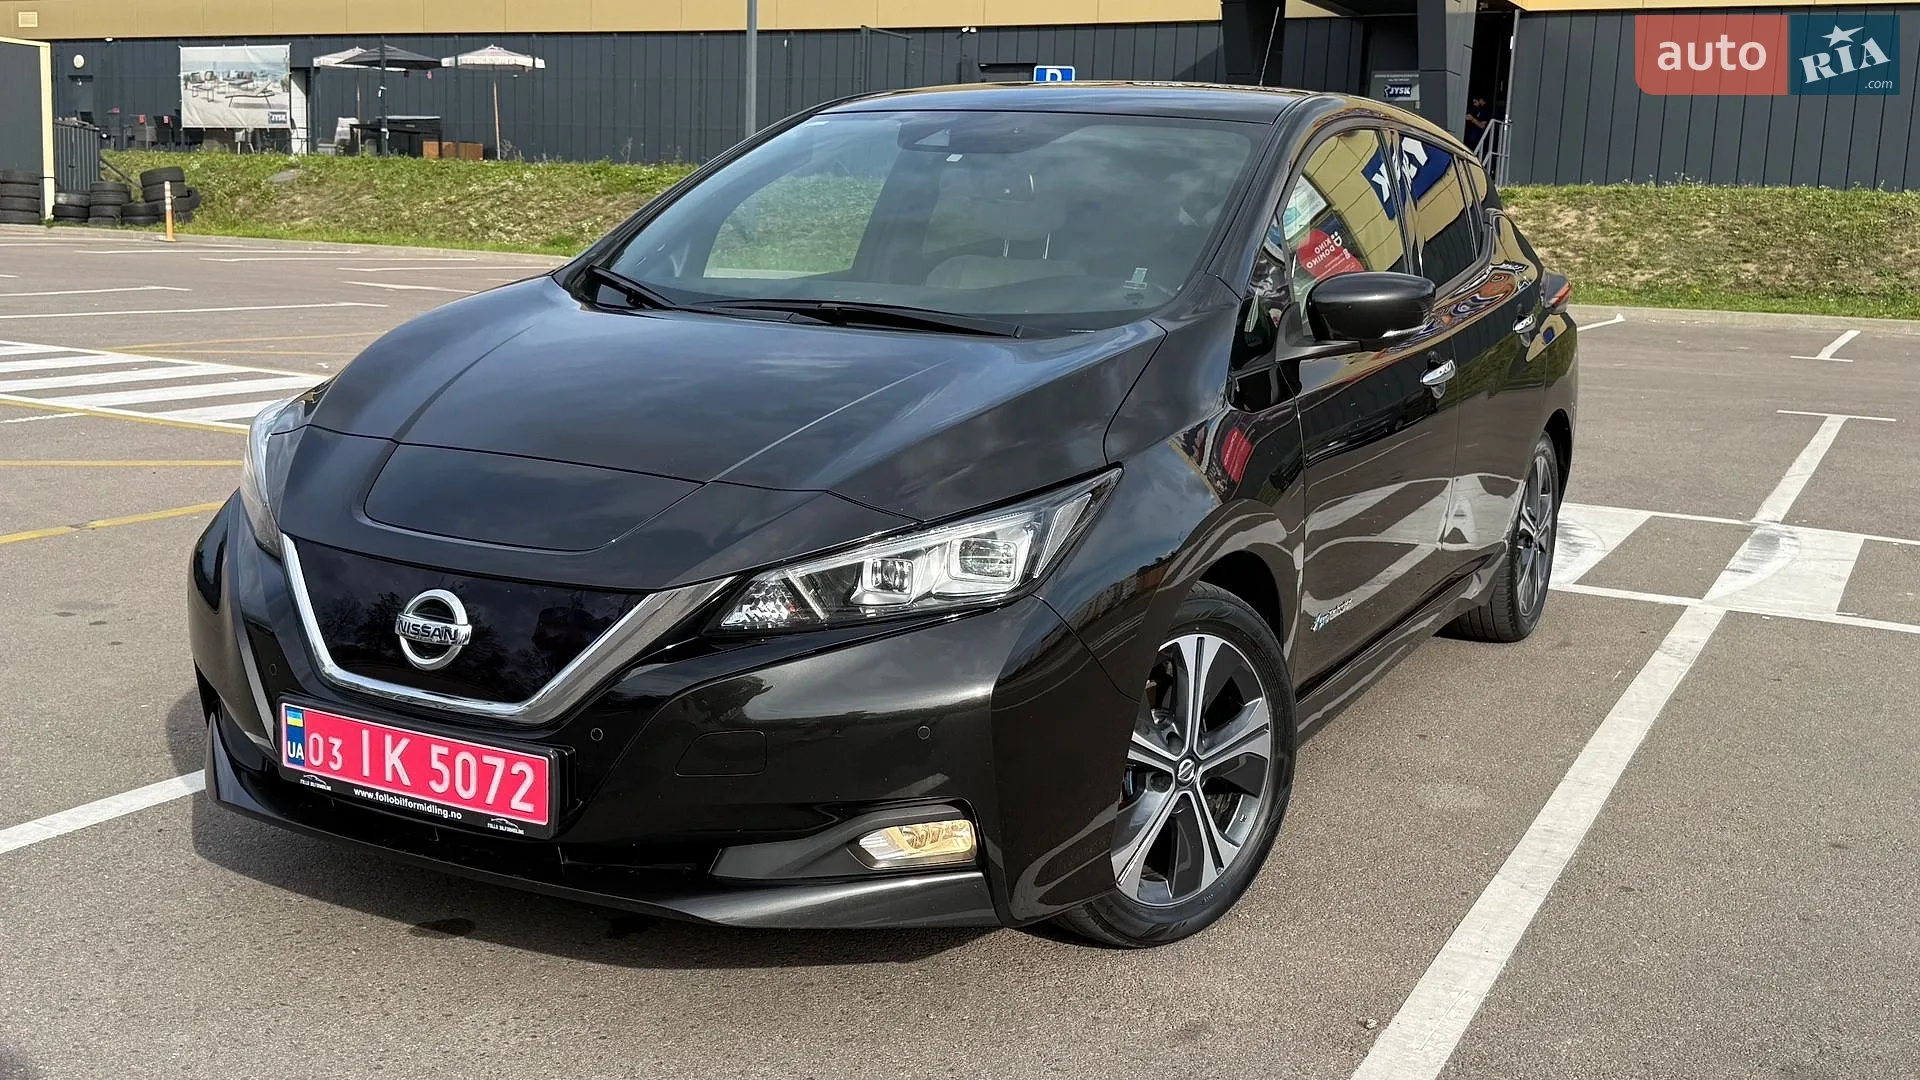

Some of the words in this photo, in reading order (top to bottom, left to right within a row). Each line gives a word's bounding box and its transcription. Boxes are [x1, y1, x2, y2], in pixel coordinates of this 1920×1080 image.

[1389, 87, 1411, 95] JYSK
[398, 619, 459, 641] NISSAN
[287, 741, 305, 760] UA
[308, 732, 343, 771] 03
[428, 744, 535, 814] 5072
